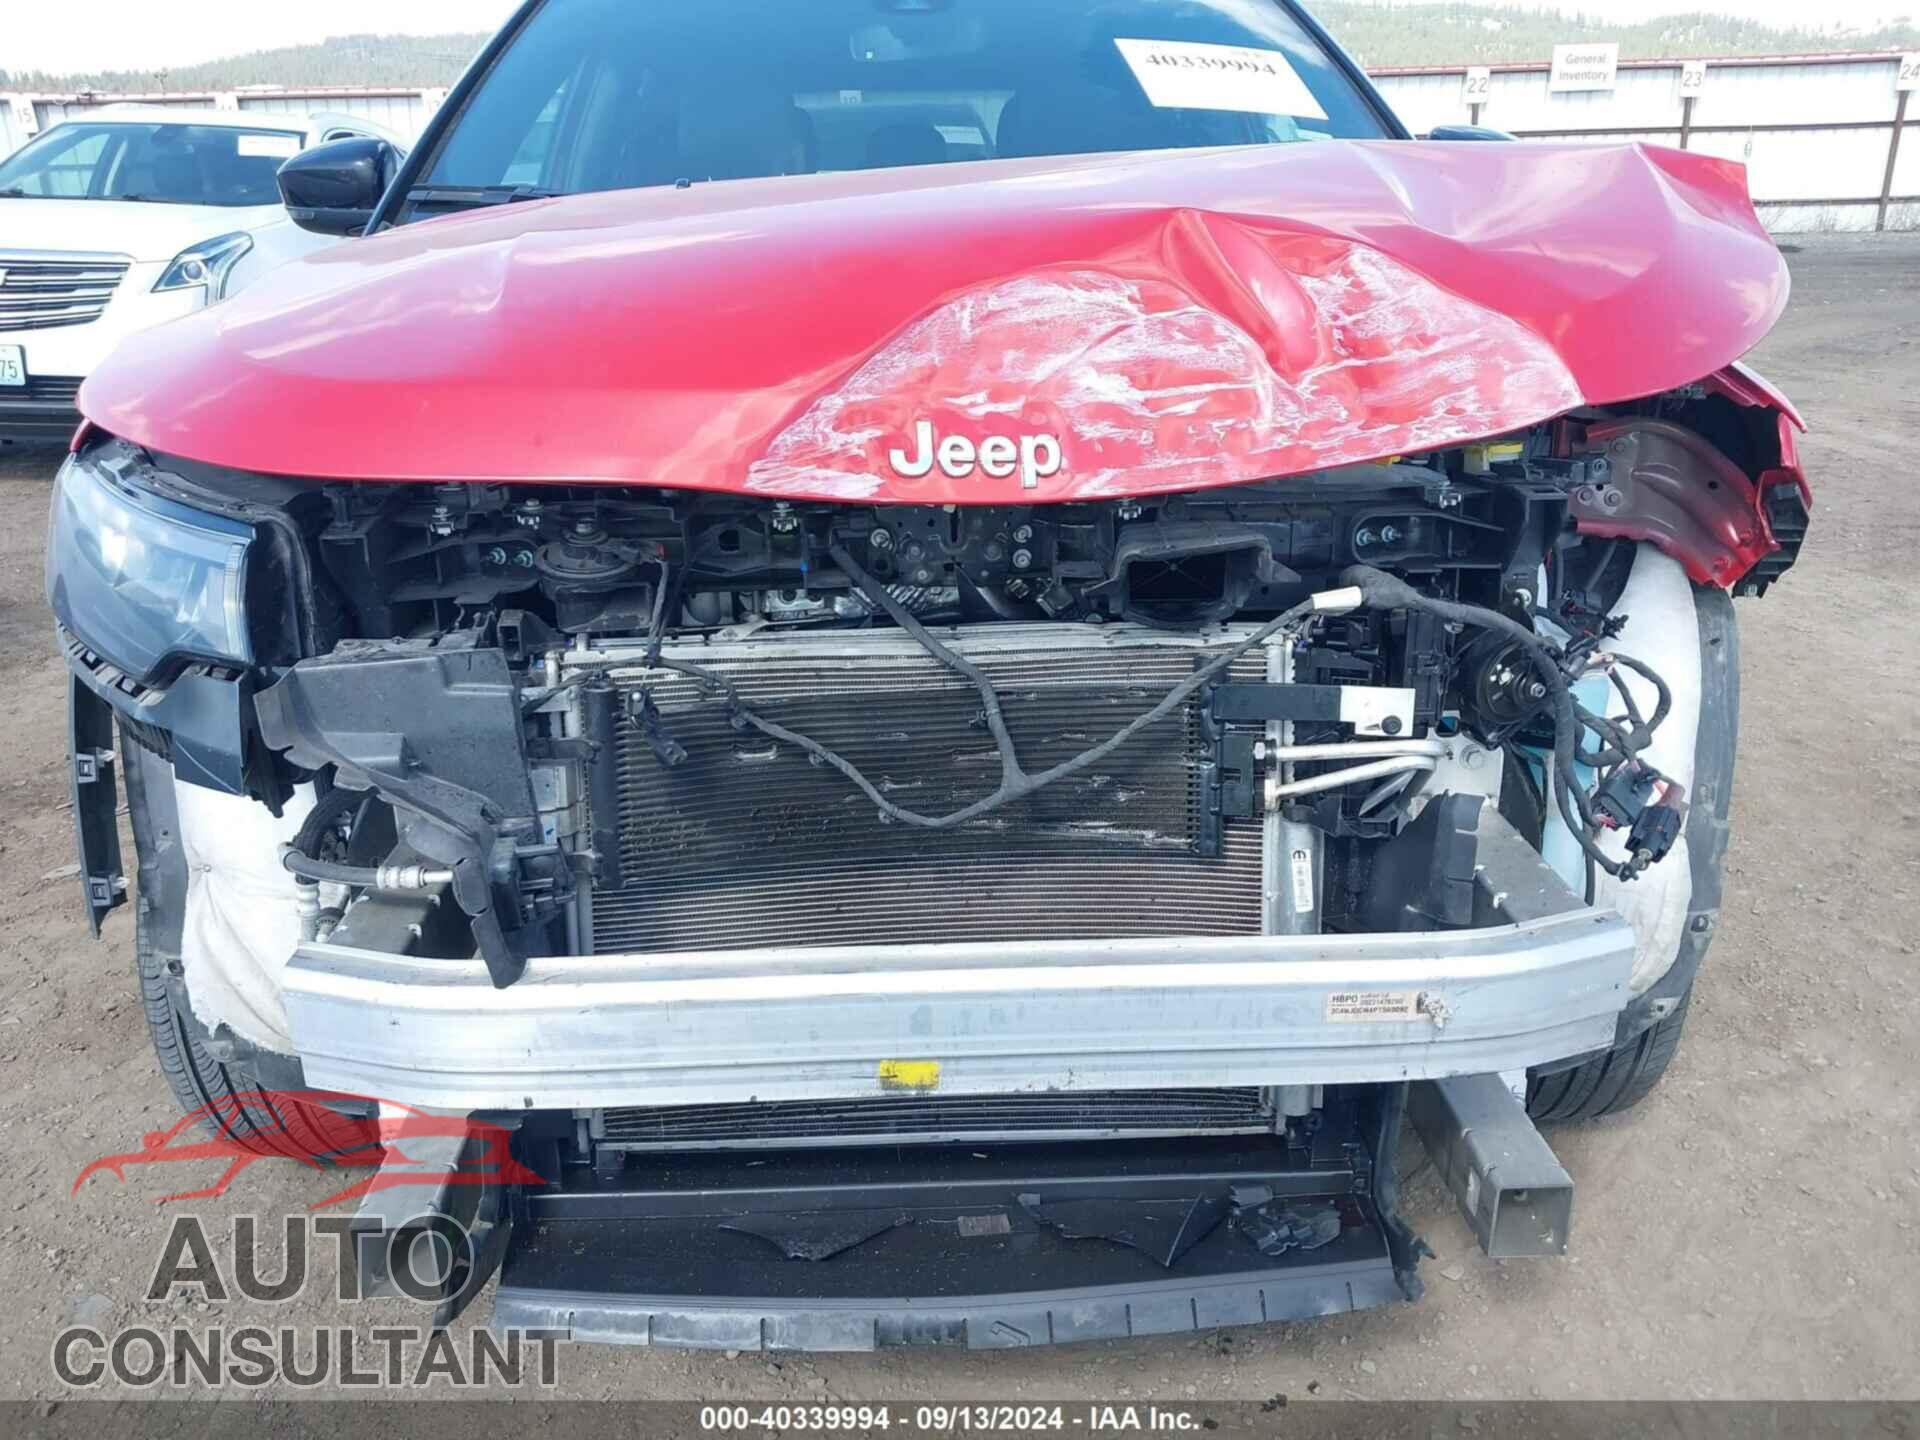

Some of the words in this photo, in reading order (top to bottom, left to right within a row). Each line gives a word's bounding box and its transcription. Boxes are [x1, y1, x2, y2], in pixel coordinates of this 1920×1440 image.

[1145, 53, 1277, 75] 40339994
[1565, 53, 1607, 65] General
[1682, 70, 1702, 88] 23
[1900, 62, 1920, 81] 24
[1467, 76, 1489, 94] 22
[888, 419, 1063, 489] Jeep
